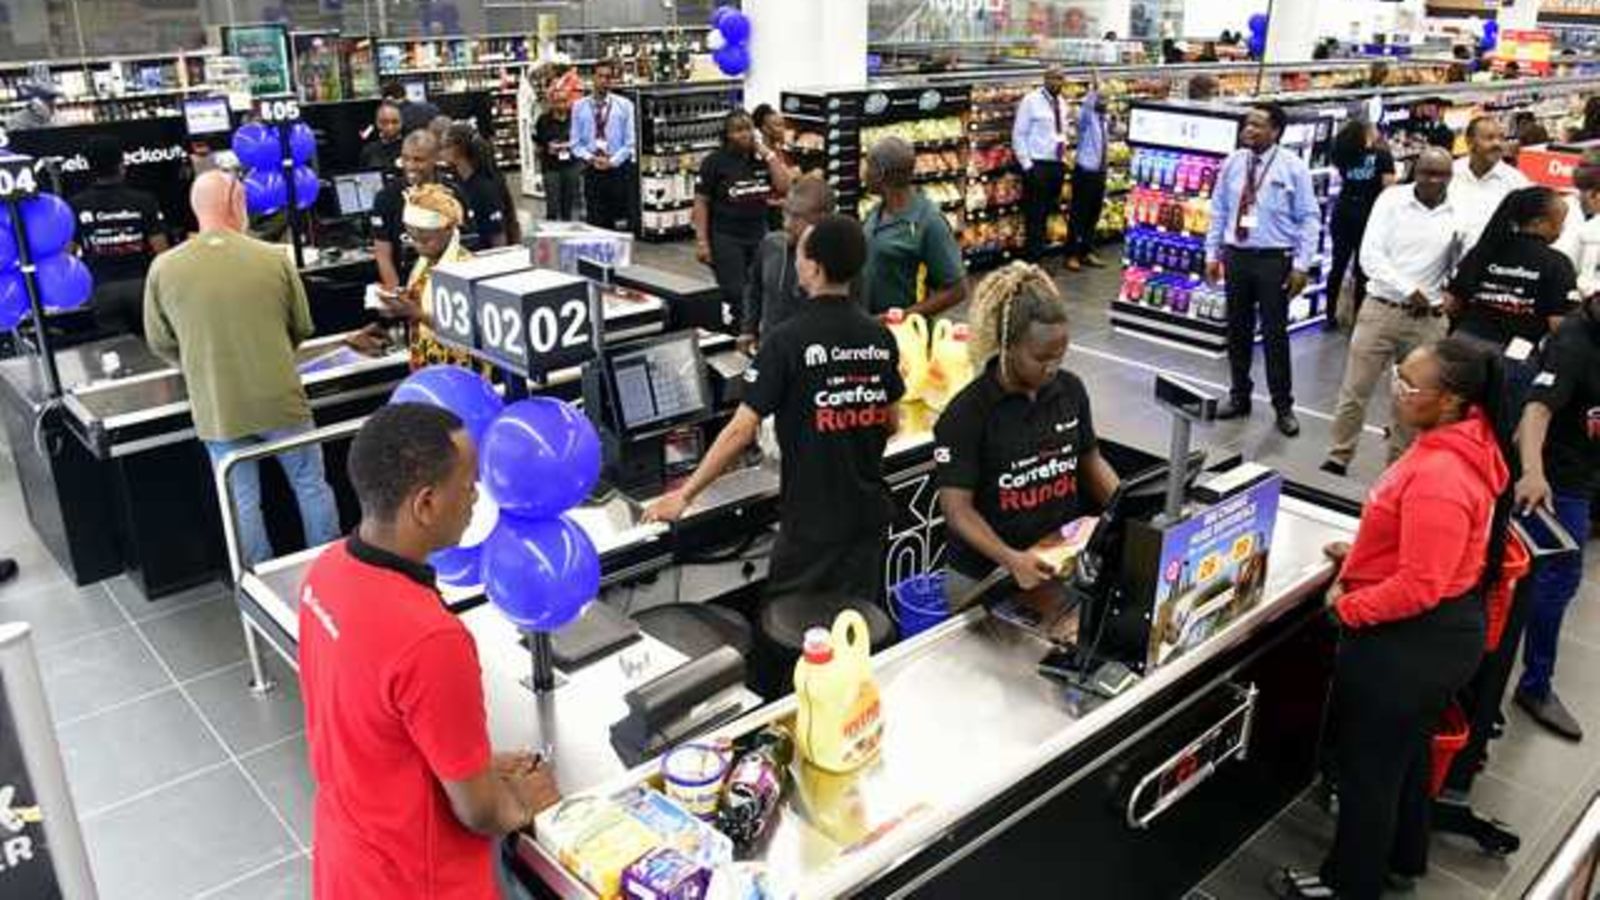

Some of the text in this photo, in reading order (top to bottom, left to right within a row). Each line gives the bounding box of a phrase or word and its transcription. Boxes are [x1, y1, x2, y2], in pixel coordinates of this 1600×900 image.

[436, 286, 470, 335] 03
[483, 302, 523, 354] 02
[529, 299, 589, 352] 02
